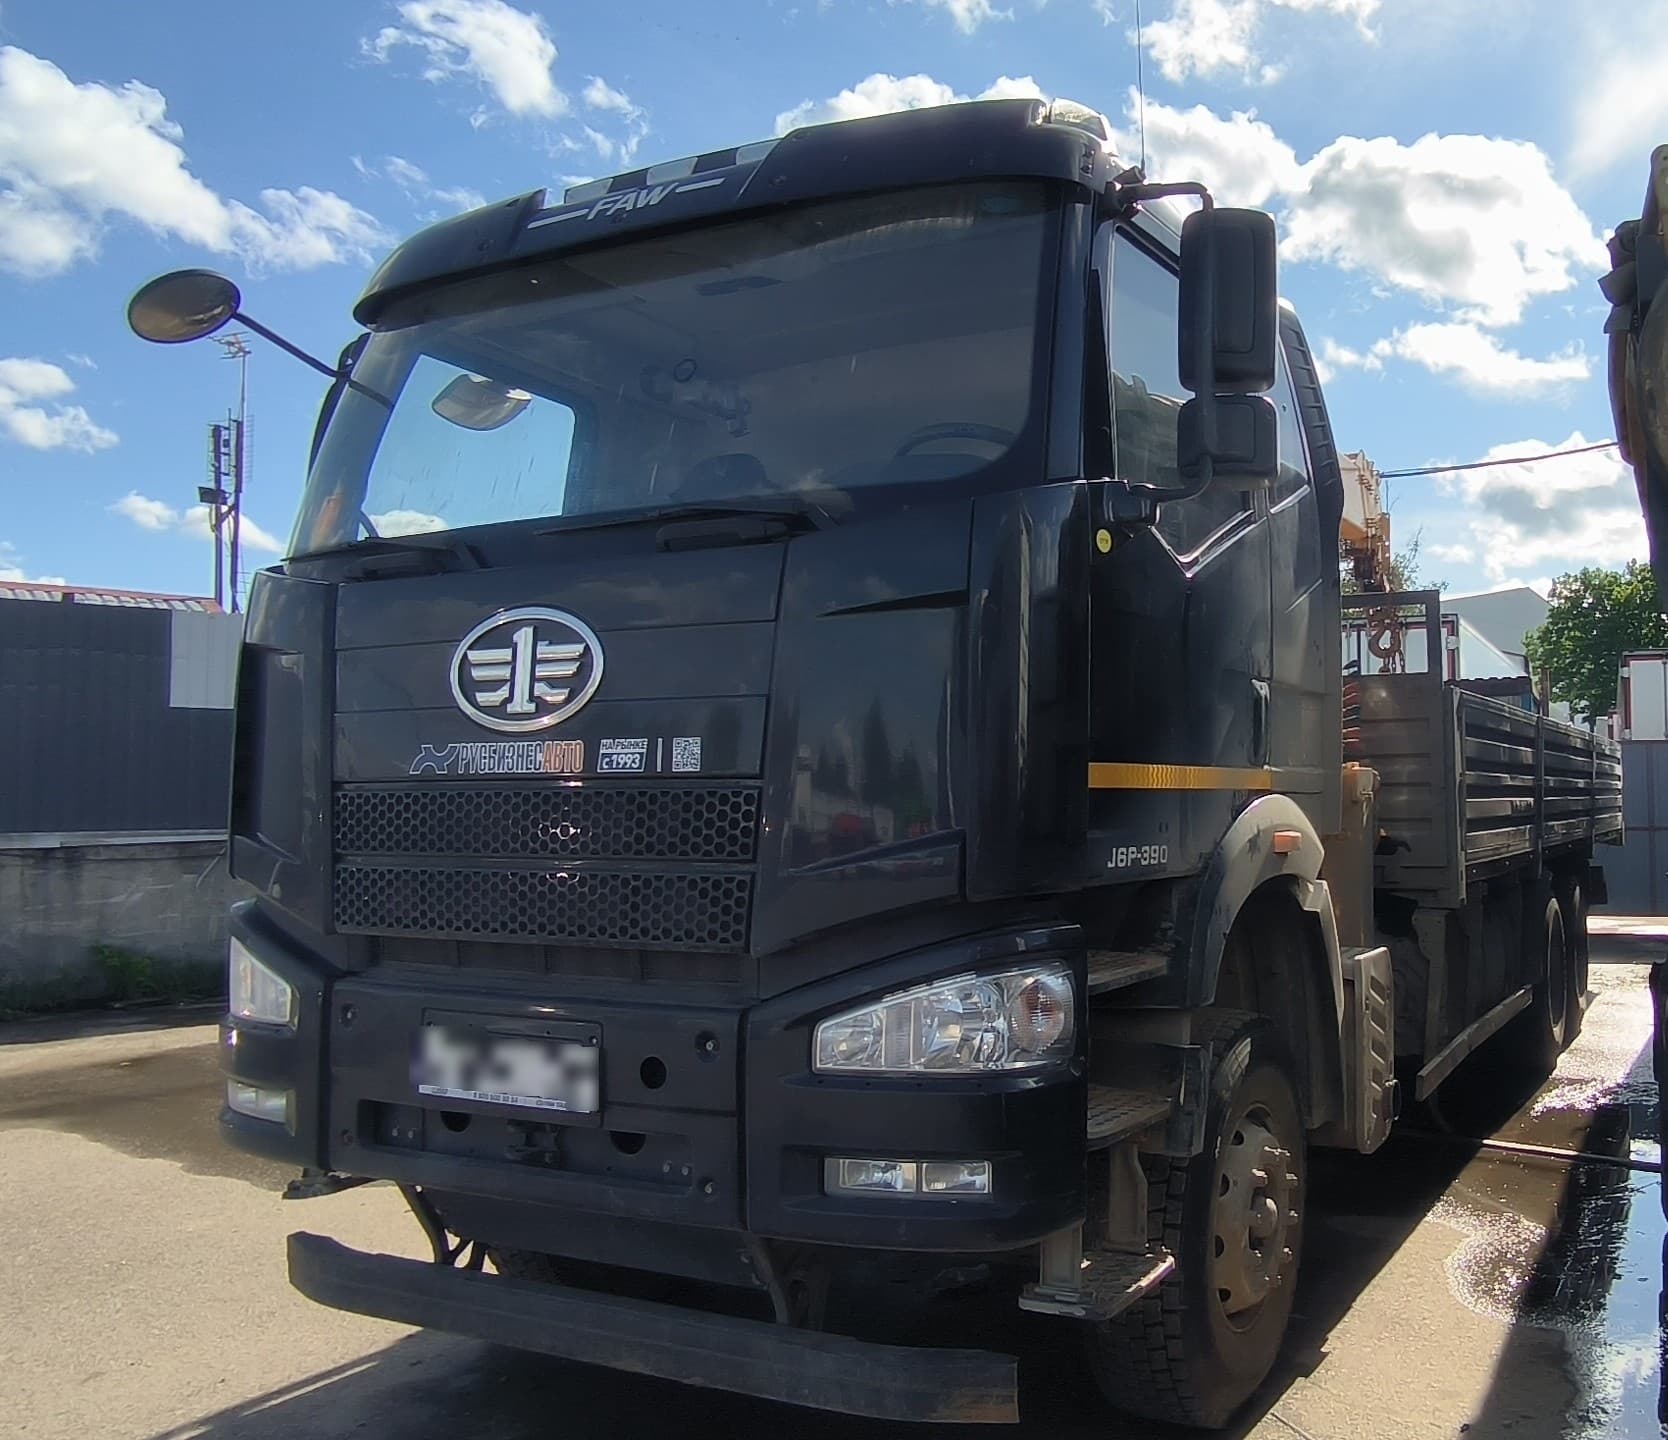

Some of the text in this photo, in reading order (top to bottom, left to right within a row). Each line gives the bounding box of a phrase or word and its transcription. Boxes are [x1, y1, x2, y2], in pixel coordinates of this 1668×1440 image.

[587, 182, 679, 220] FAW
[458, 740, 584, 774] РУСБИЗНЕСАВТО
[1107, 844, 1168, 867] J6P-390
